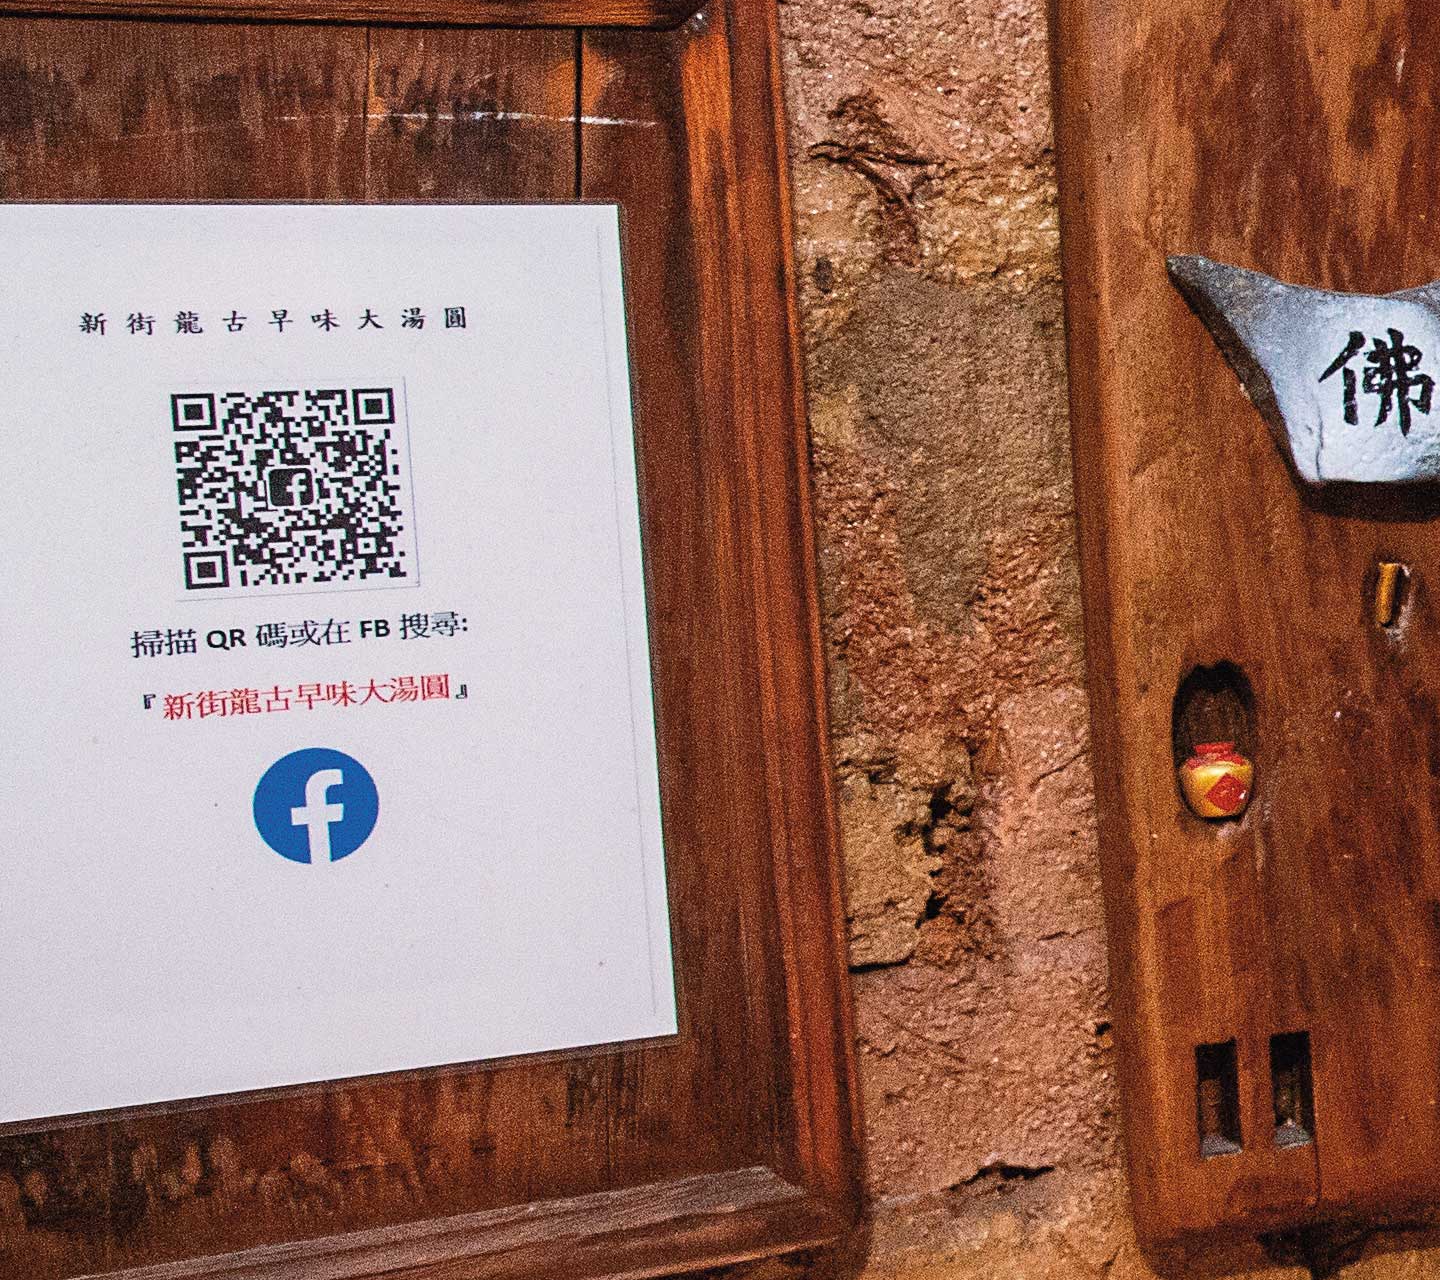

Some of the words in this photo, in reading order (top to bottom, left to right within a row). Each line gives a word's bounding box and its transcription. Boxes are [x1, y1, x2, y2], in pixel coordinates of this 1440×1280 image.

[78, 305, 468, 337] 新街龍古早味大湯圓
[1318, 327, 1436, 438] 佛
[131, 626, 198, 658] 掃描
[206, 627, 248, 652] QR
[256, 618, 352, 651] 碼或在
[360, 616, 391, 640] FB
